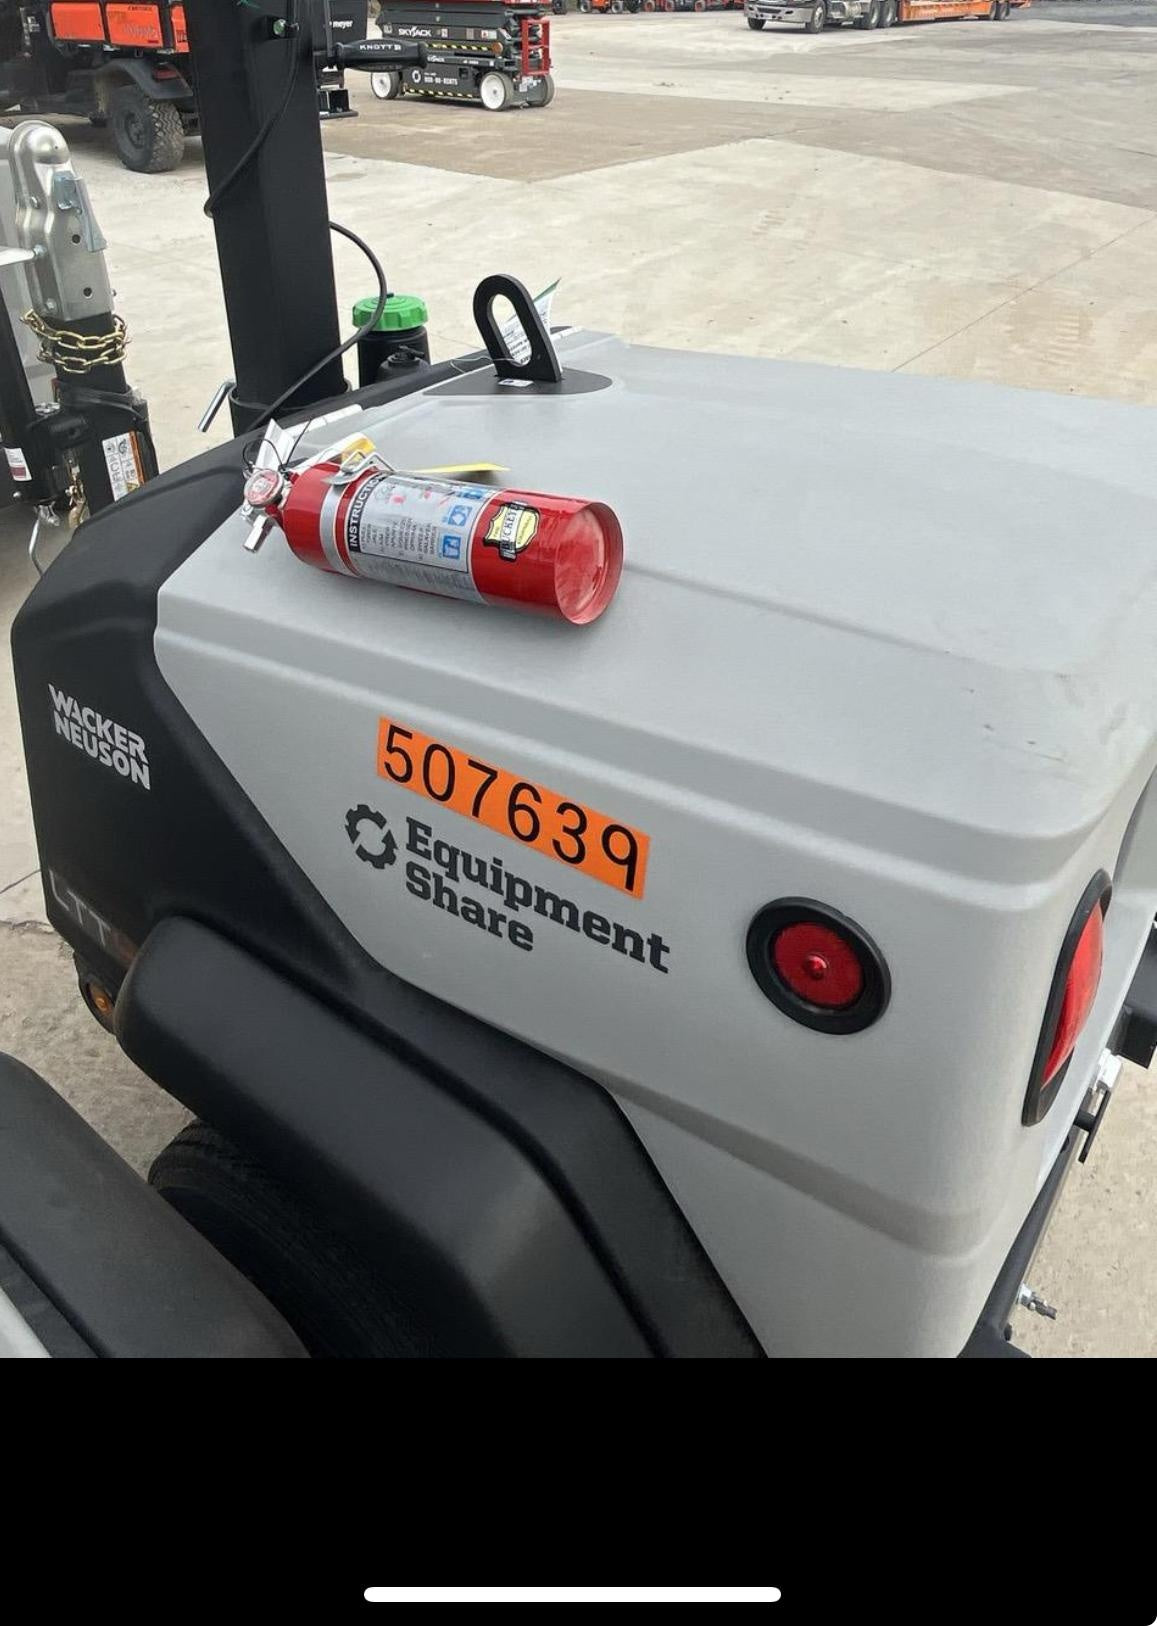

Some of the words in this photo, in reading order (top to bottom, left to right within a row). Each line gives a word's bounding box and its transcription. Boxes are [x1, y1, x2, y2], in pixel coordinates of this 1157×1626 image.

[398, 26, 432, 37] SKYJACK
[48, 684, 149, 764] WACKER
[54, 711, 151, 791] NEUSON
[383, 724, 640, 892] 507639
[405, 816, 672, 973] Equipment
[405, 861, 534, 951] Share
